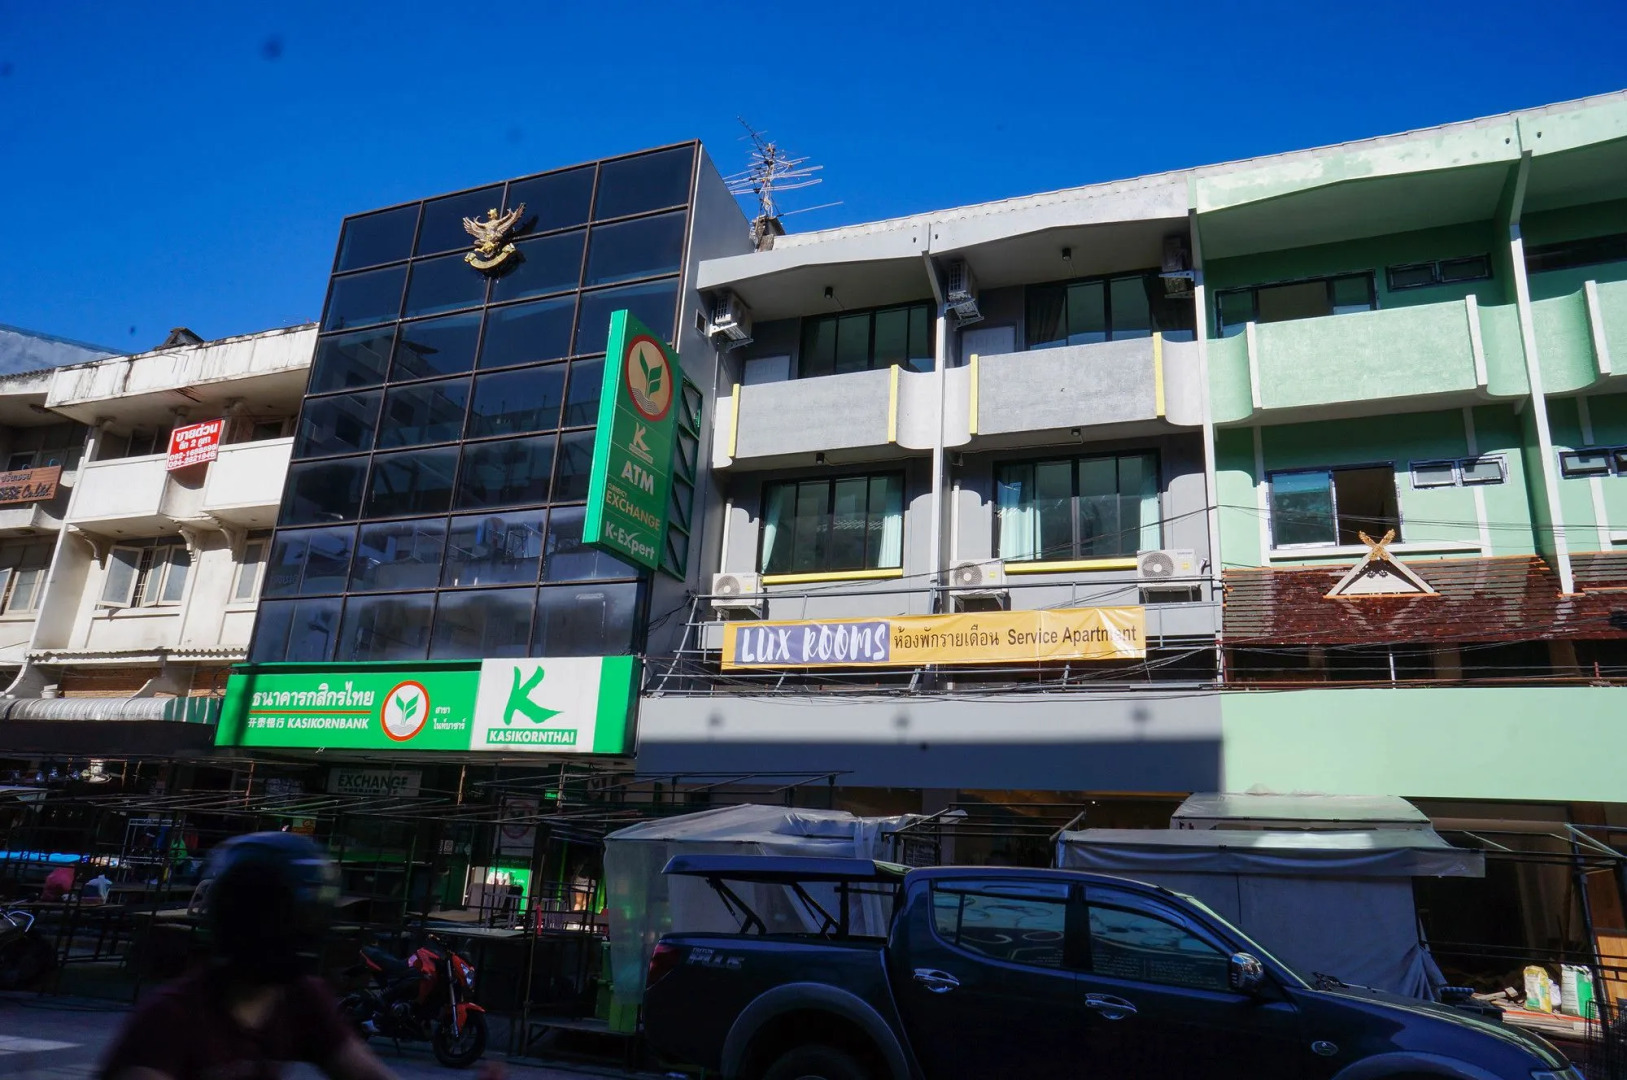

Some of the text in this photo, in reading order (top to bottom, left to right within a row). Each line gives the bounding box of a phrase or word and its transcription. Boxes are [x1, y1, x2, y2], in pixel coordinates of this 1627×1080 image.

[176, 423, 219, 442] ขายด่วน
[190, 439, 197, 448] 2
[621, 460, 654, 496] ATM
[606, 490, 661, 532] EXCHANGE
[742, 624, 885, 662] LUX ROOMS
[894, 624, 1000, 650] ห้องพักรายเดือน
[1008, 628, 1058, 645] Service
[252, 681, 375, 707] ธนาคารกสิกรไทย
[503, 665, 564, 726] K
[287, 718, 370, 729] KASIKORNBANK
[490, 730, 575, 743] KASIKORNTHAI
[338, 774, 408, 789] EXCHANGE
